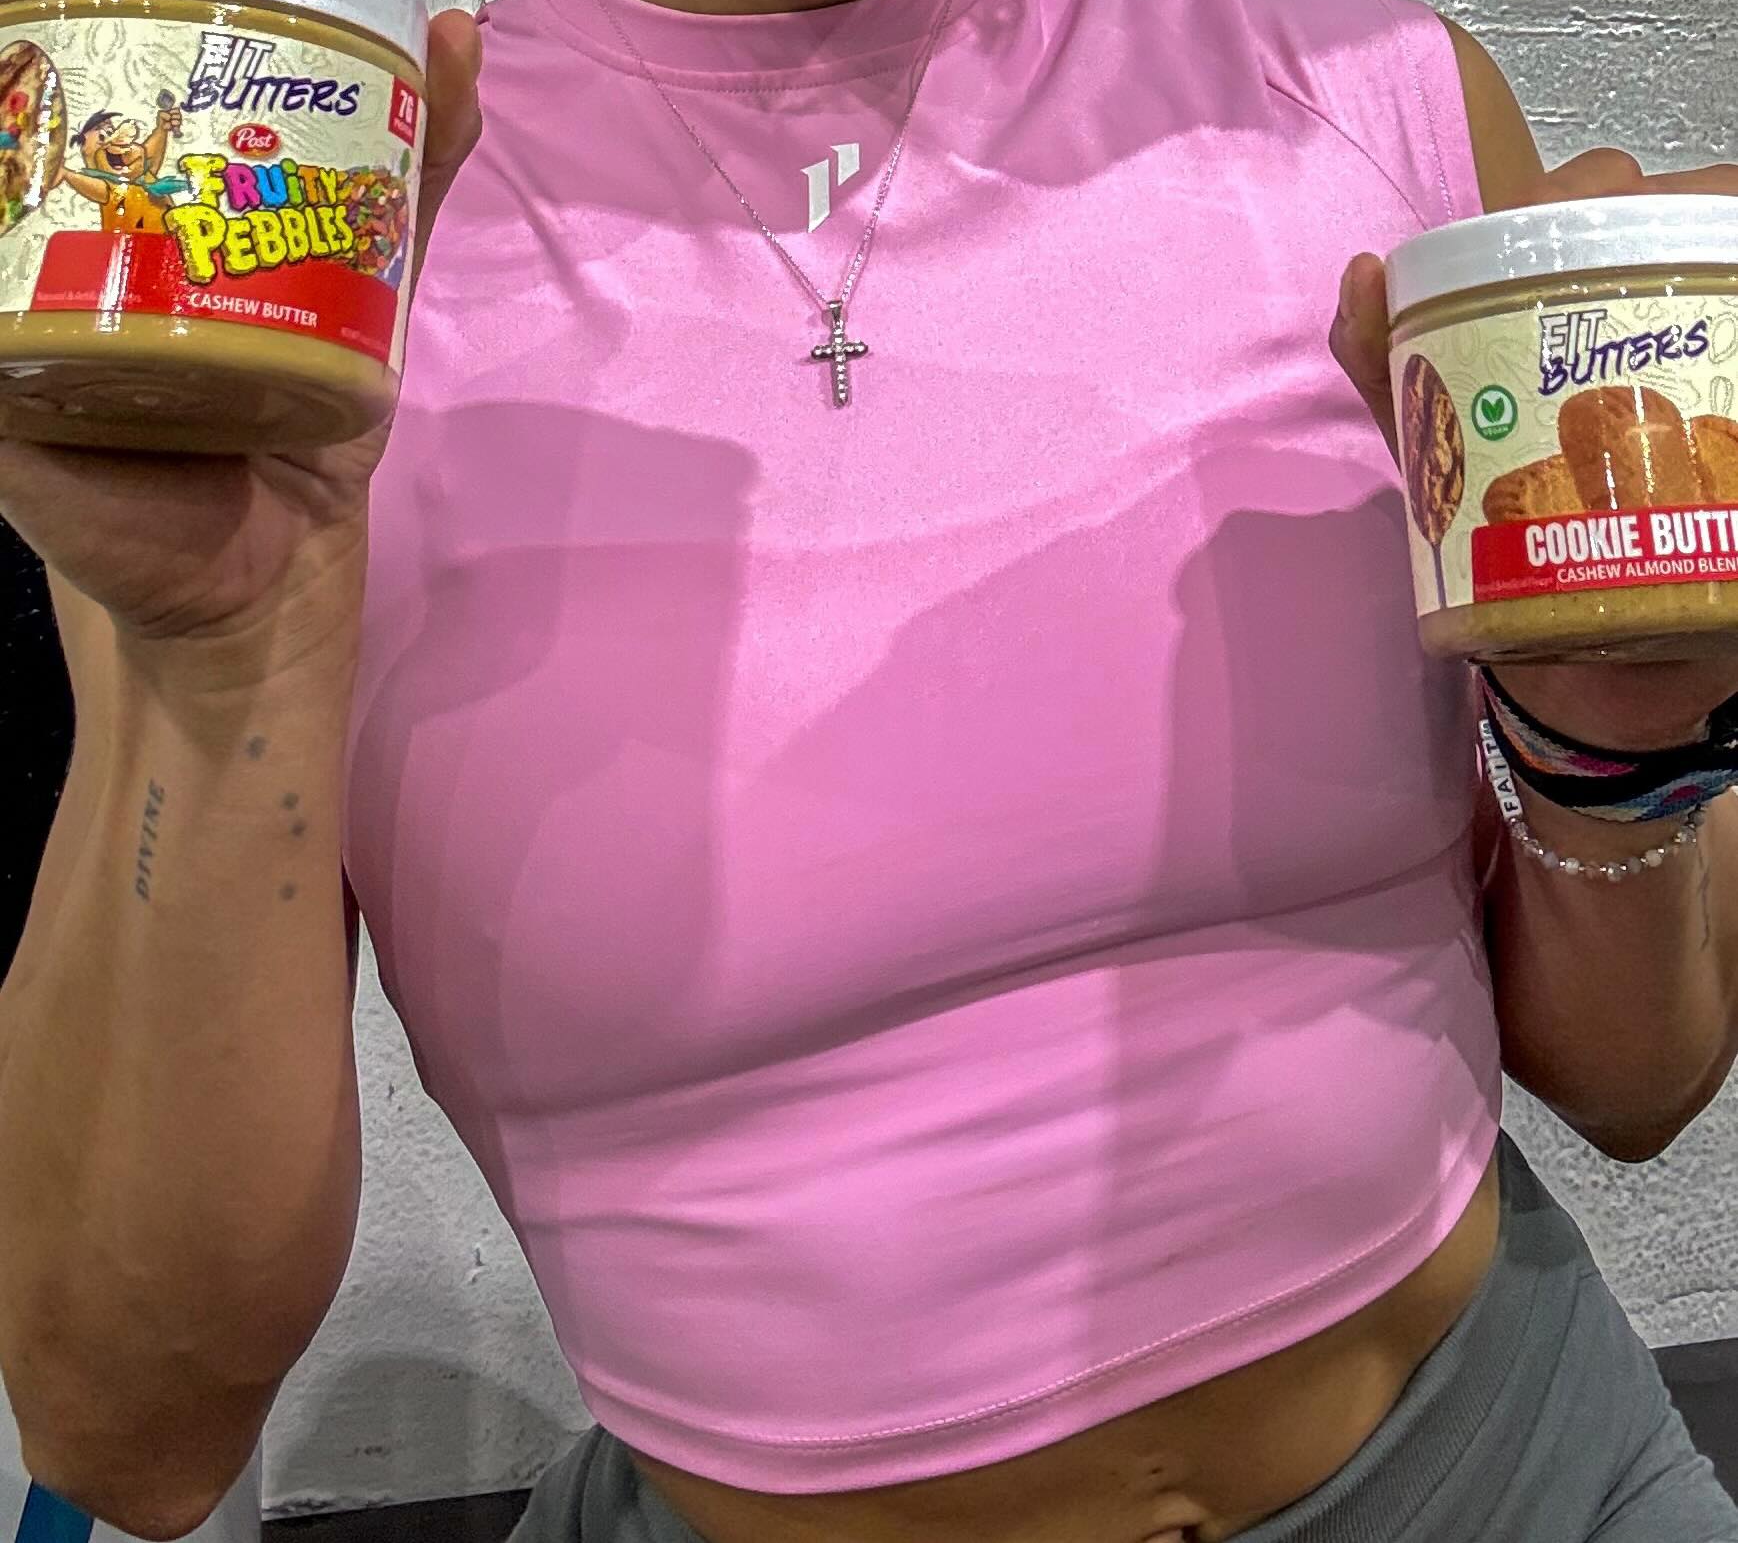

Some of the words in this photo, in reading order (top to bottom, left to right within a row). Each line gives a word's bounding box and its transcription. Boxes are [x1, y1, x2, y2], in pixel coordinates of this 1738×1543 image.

[189, 31, 276, 89] FIT
[181, 76, 360, 116] BUTTERS
[236, 127, 273, 149] Post
[163, 202, 354, 285] PEBBLES
[190, 292, 260, 317] CASHEW
[262, 302, 318, 328] BUTTER
[1538, 319, 1710, 396] BUTTERS
[1539, 309, 1608, 373] FIT
[1525, 515, 1643, 568] COOKIE
[1557, 563, 1621, 584] CASHEW
[1625, 559, 1695, 578] ALMOND
[1699, 557, 1738, 573] BLEN
